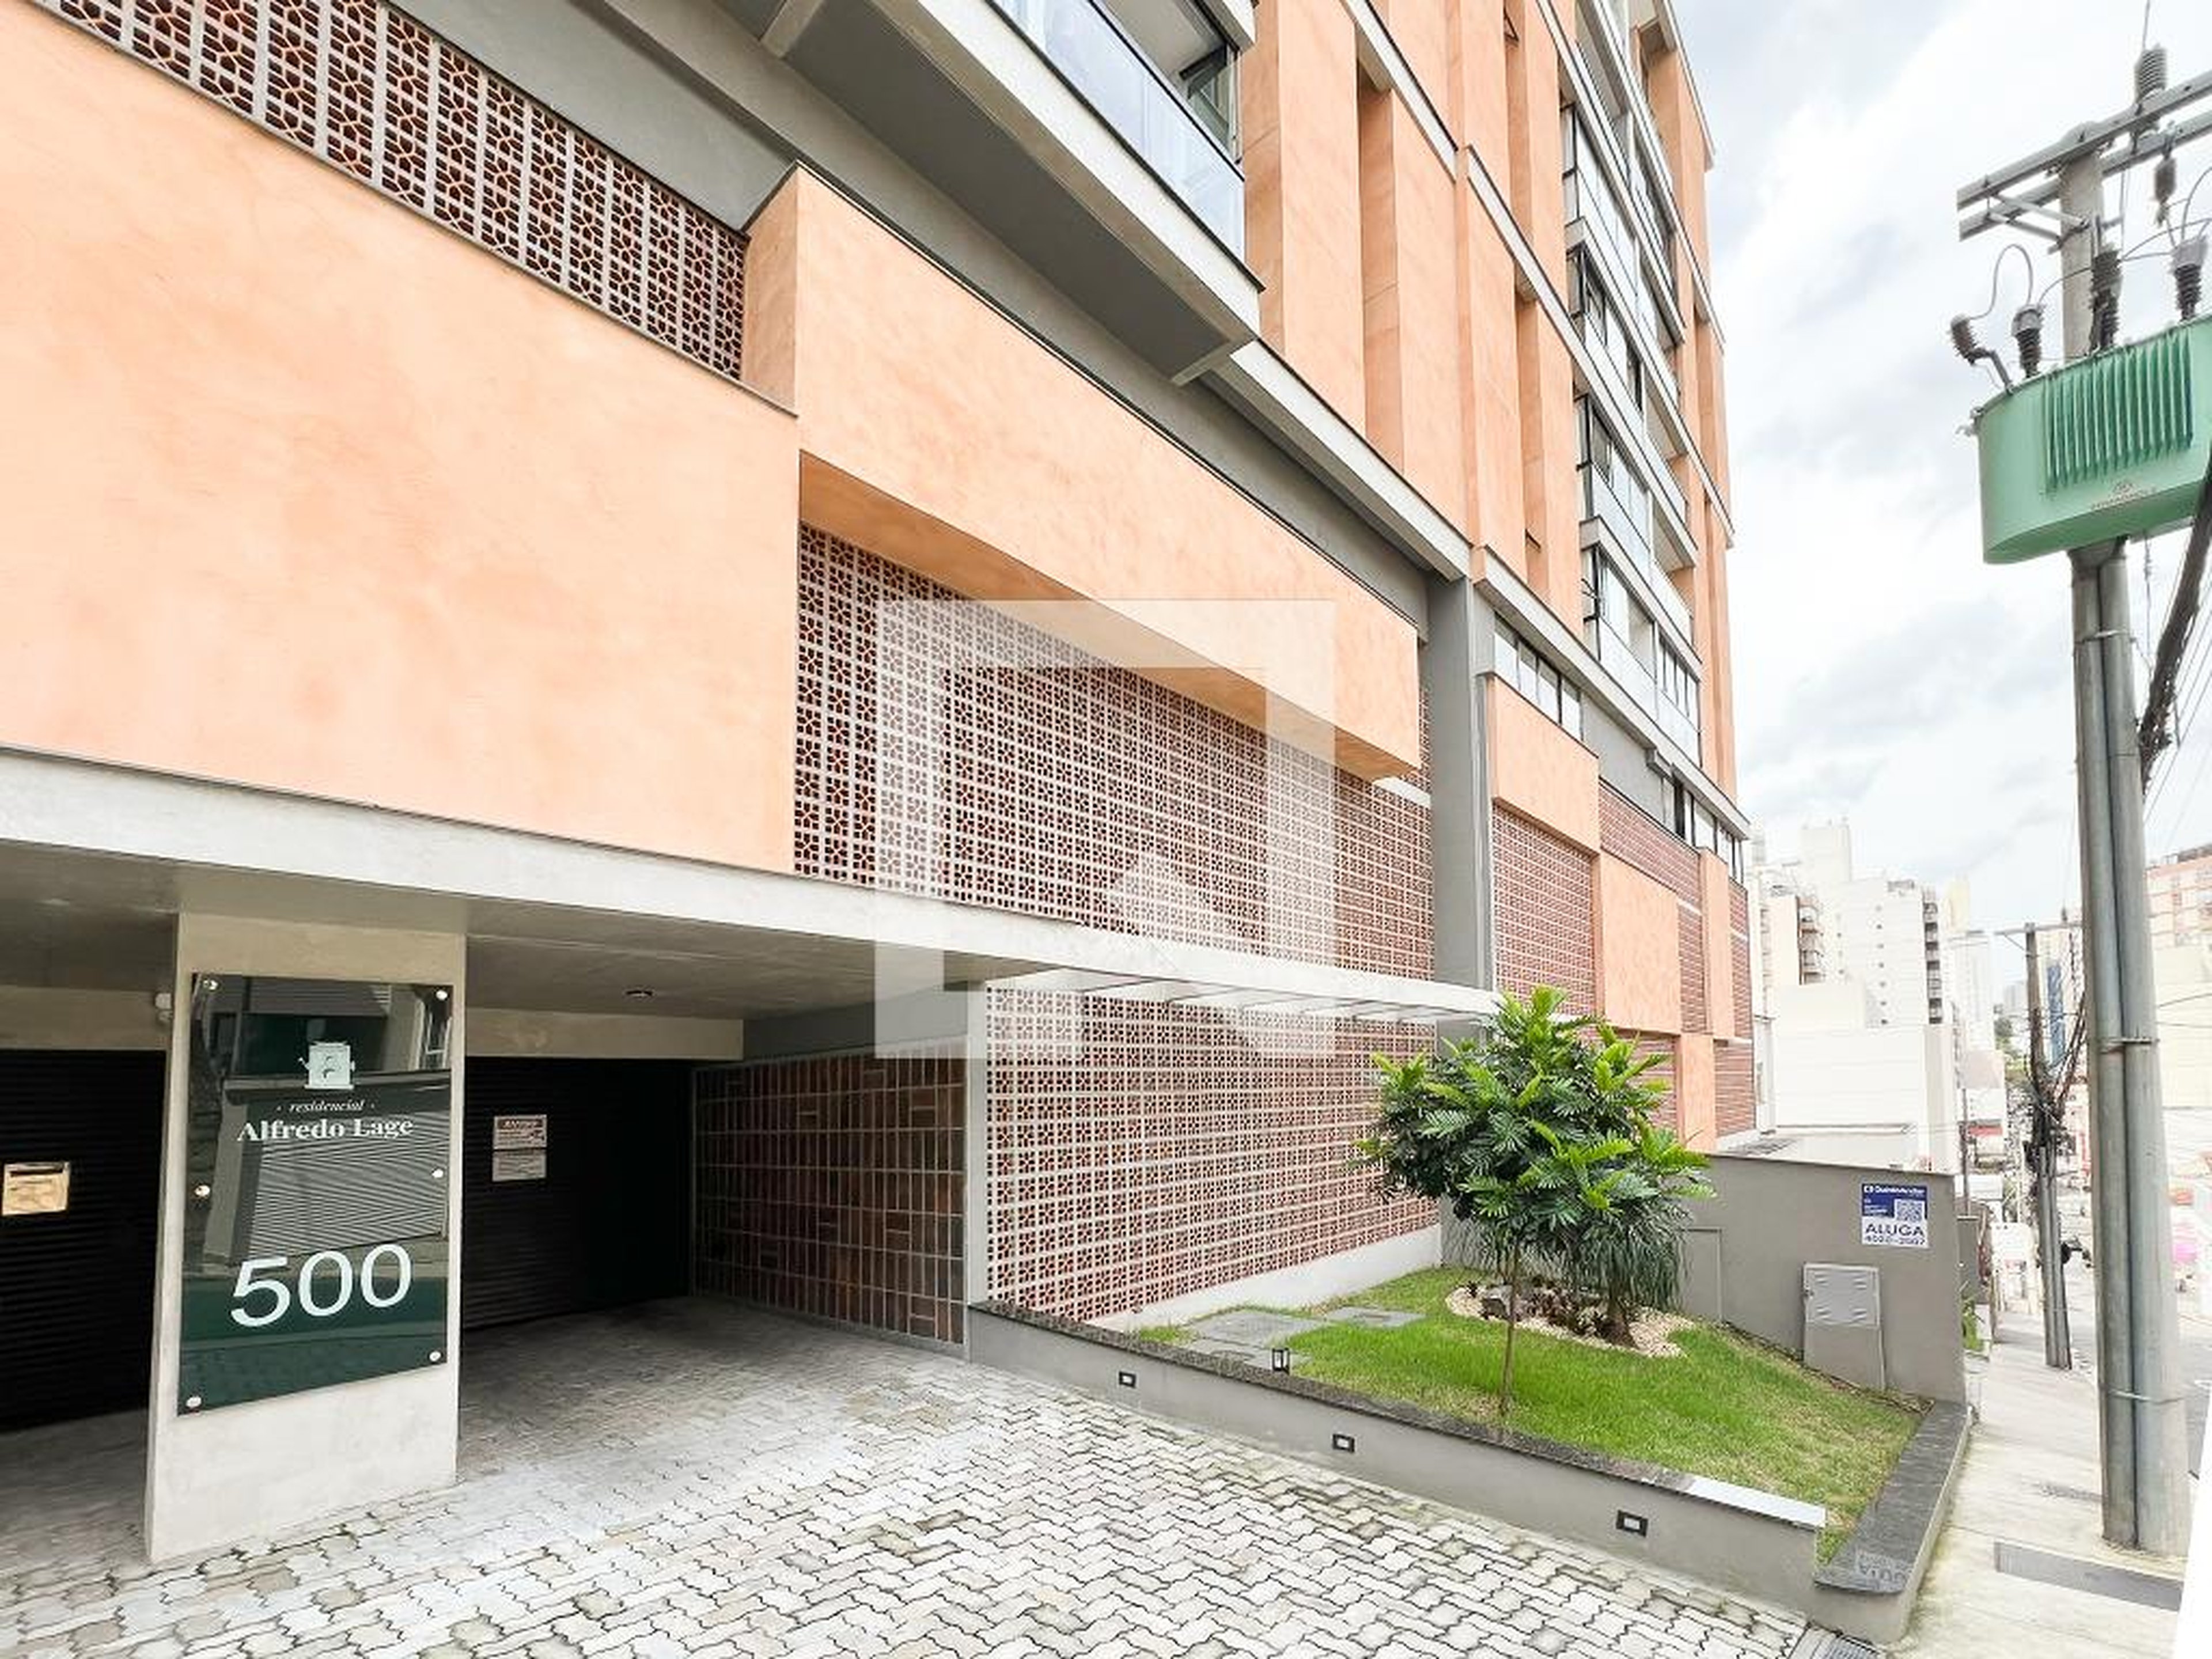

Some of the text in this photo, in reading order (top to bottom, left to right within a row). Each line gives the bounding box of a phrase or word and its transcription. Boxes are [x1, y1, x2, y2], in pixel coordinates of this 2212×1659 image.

[289, 1099, 366, 1112] residencial
[237, 1118, 414, 1142] Alfredo Lage
[1865, 1224, 1925, 1237] ALUGA
[231, 1244, 411, 1325] 500
